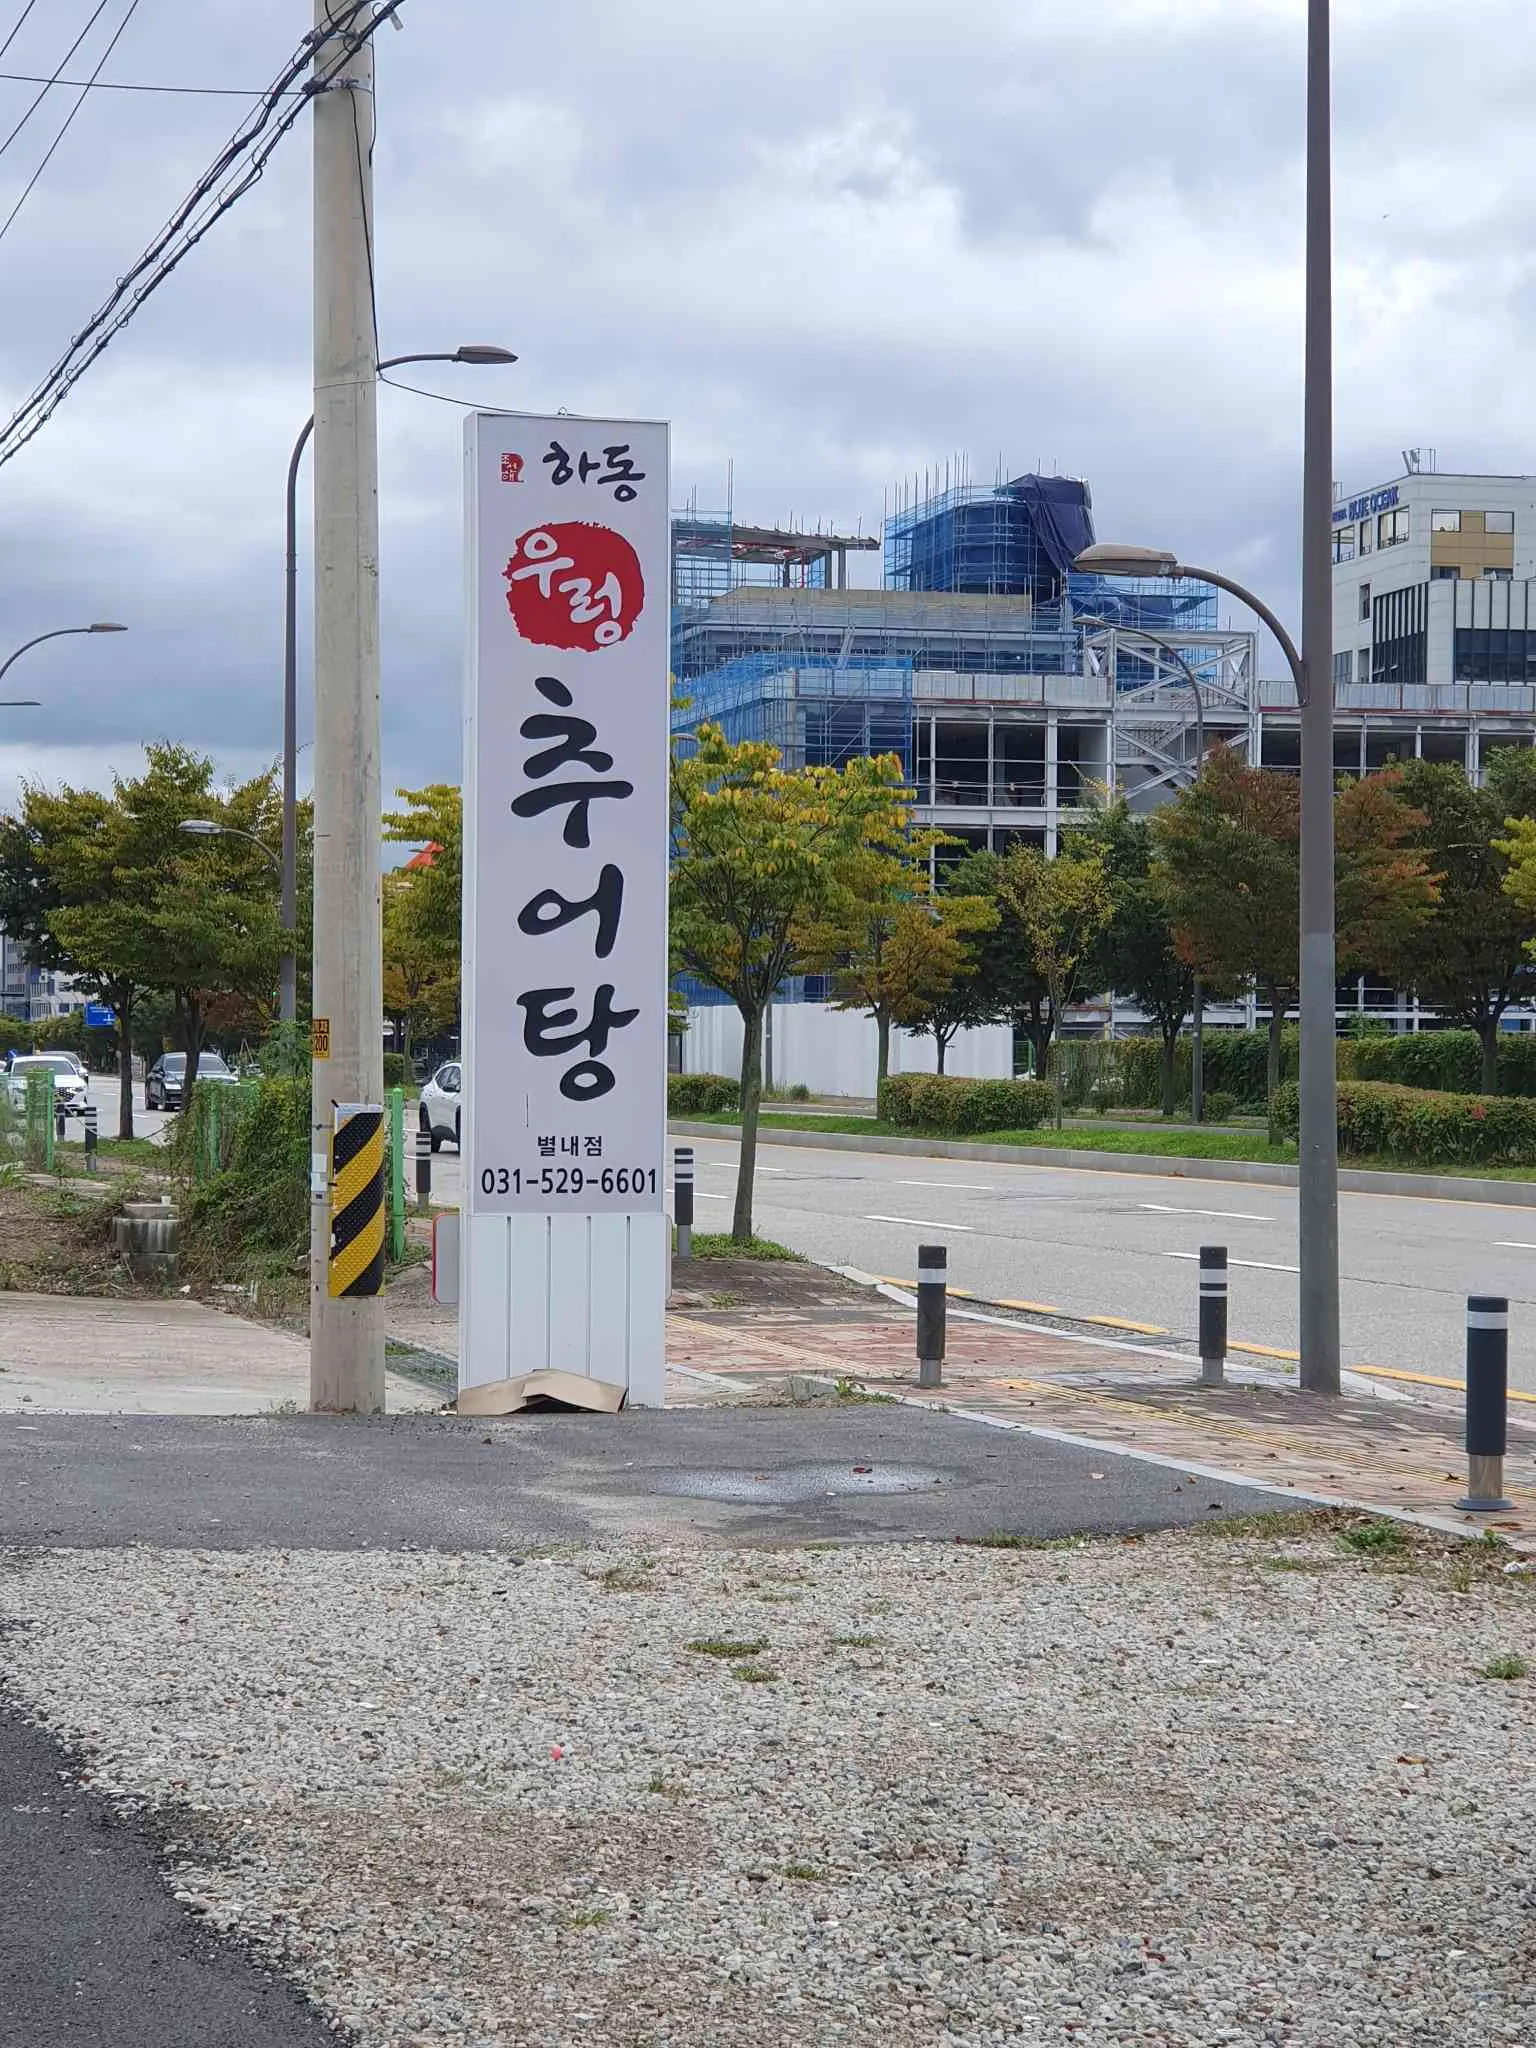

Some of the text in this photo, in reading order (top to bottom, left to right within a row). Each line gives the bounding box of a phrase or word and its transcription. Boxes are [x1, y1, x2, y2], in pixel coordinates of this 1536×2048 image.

[542, 440, 646, 502] 하동
[511, 532, 623, 646] 우렁
[510, 676, 641, 1106] 추어탕
[537, 1135, 603, 1157] 별내점
[481, 1167, 657, 1195] 031-529-6601
